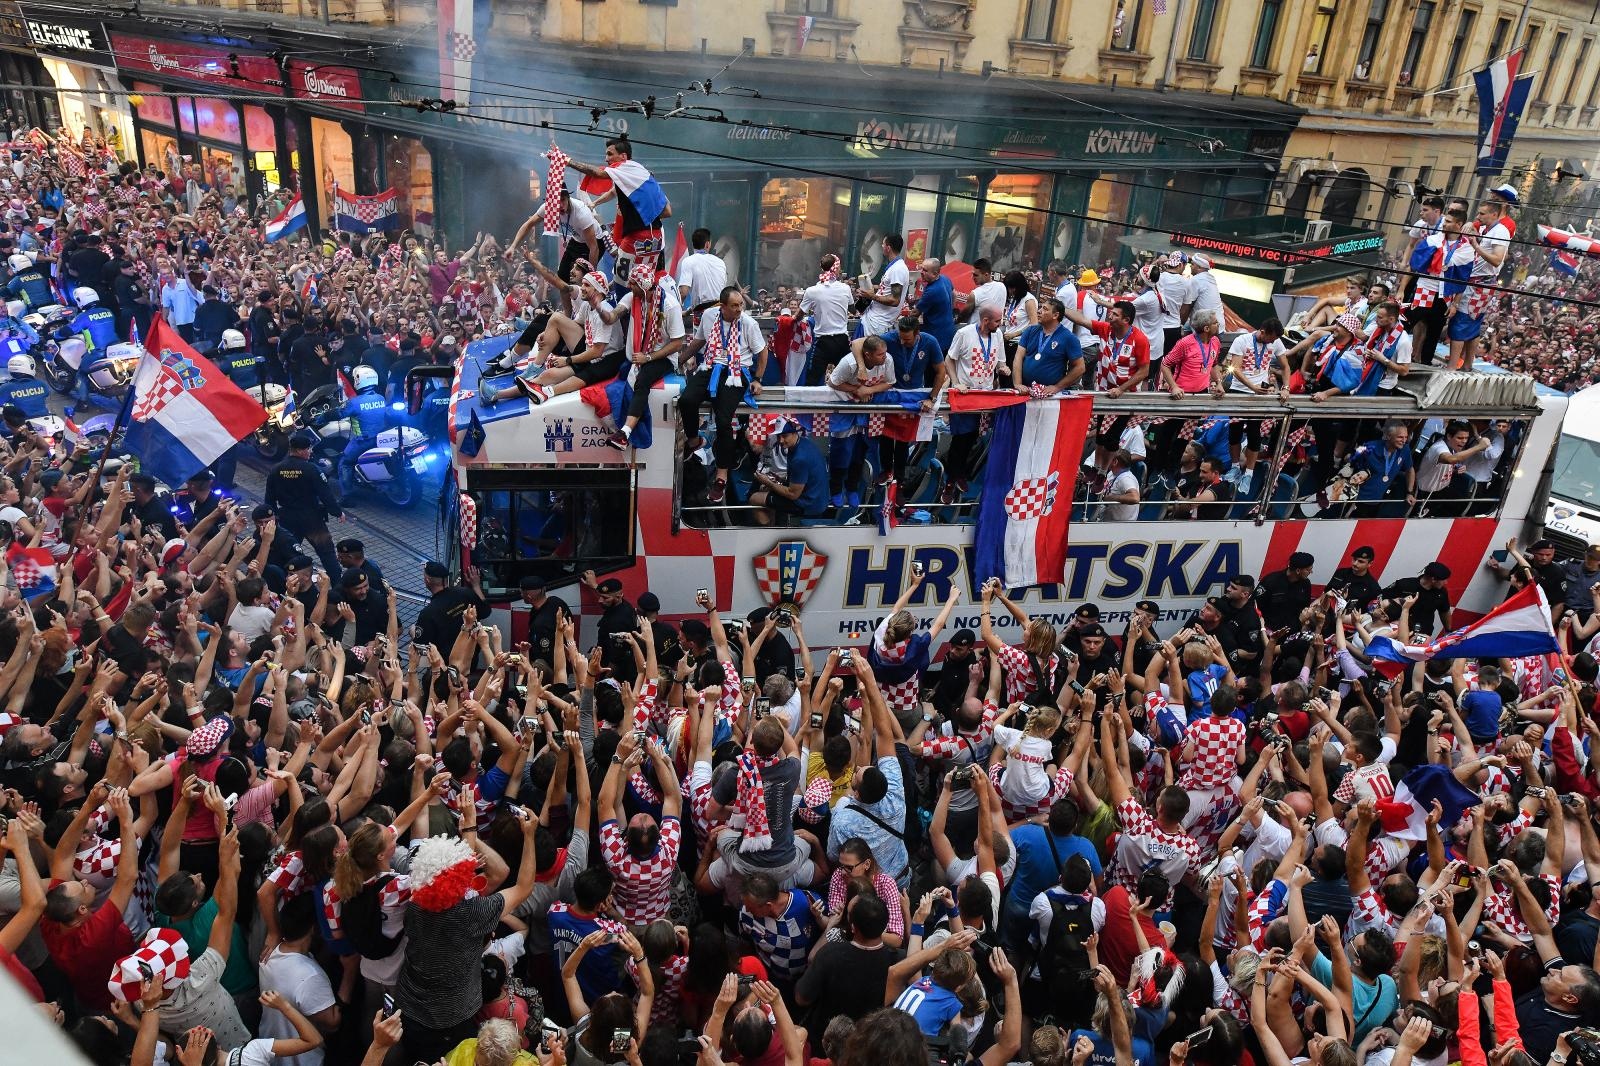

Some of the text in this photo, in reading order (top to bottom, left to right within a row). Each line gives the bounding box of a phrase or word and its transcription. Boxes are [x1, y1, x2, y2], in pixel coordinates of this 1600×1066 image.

[28, 21, 95, 50] ELEGANCE
[318, 78, 347, 97] Diana
[727, 123, 792, 141] delikatese
[854, 118, 958, 151] KONZUM
[1084, 128, 1158, 154] KONZUM
[20, 272, 43, 283] POLICIJA
[88, 310, 113, 322] POLICIJA
[231, 357, 257, 369] POLICIJ
[10, 387, 46, 399] POLICIJA
[359, 400, 386, 412] POLICIJA
[1549, 519, 1590, 539] ICIJA
[783, 549, 798, 595] HNS
[1367, 773, 1394, 800] 10
[553, 926, 584, 946] MANDŽUK
